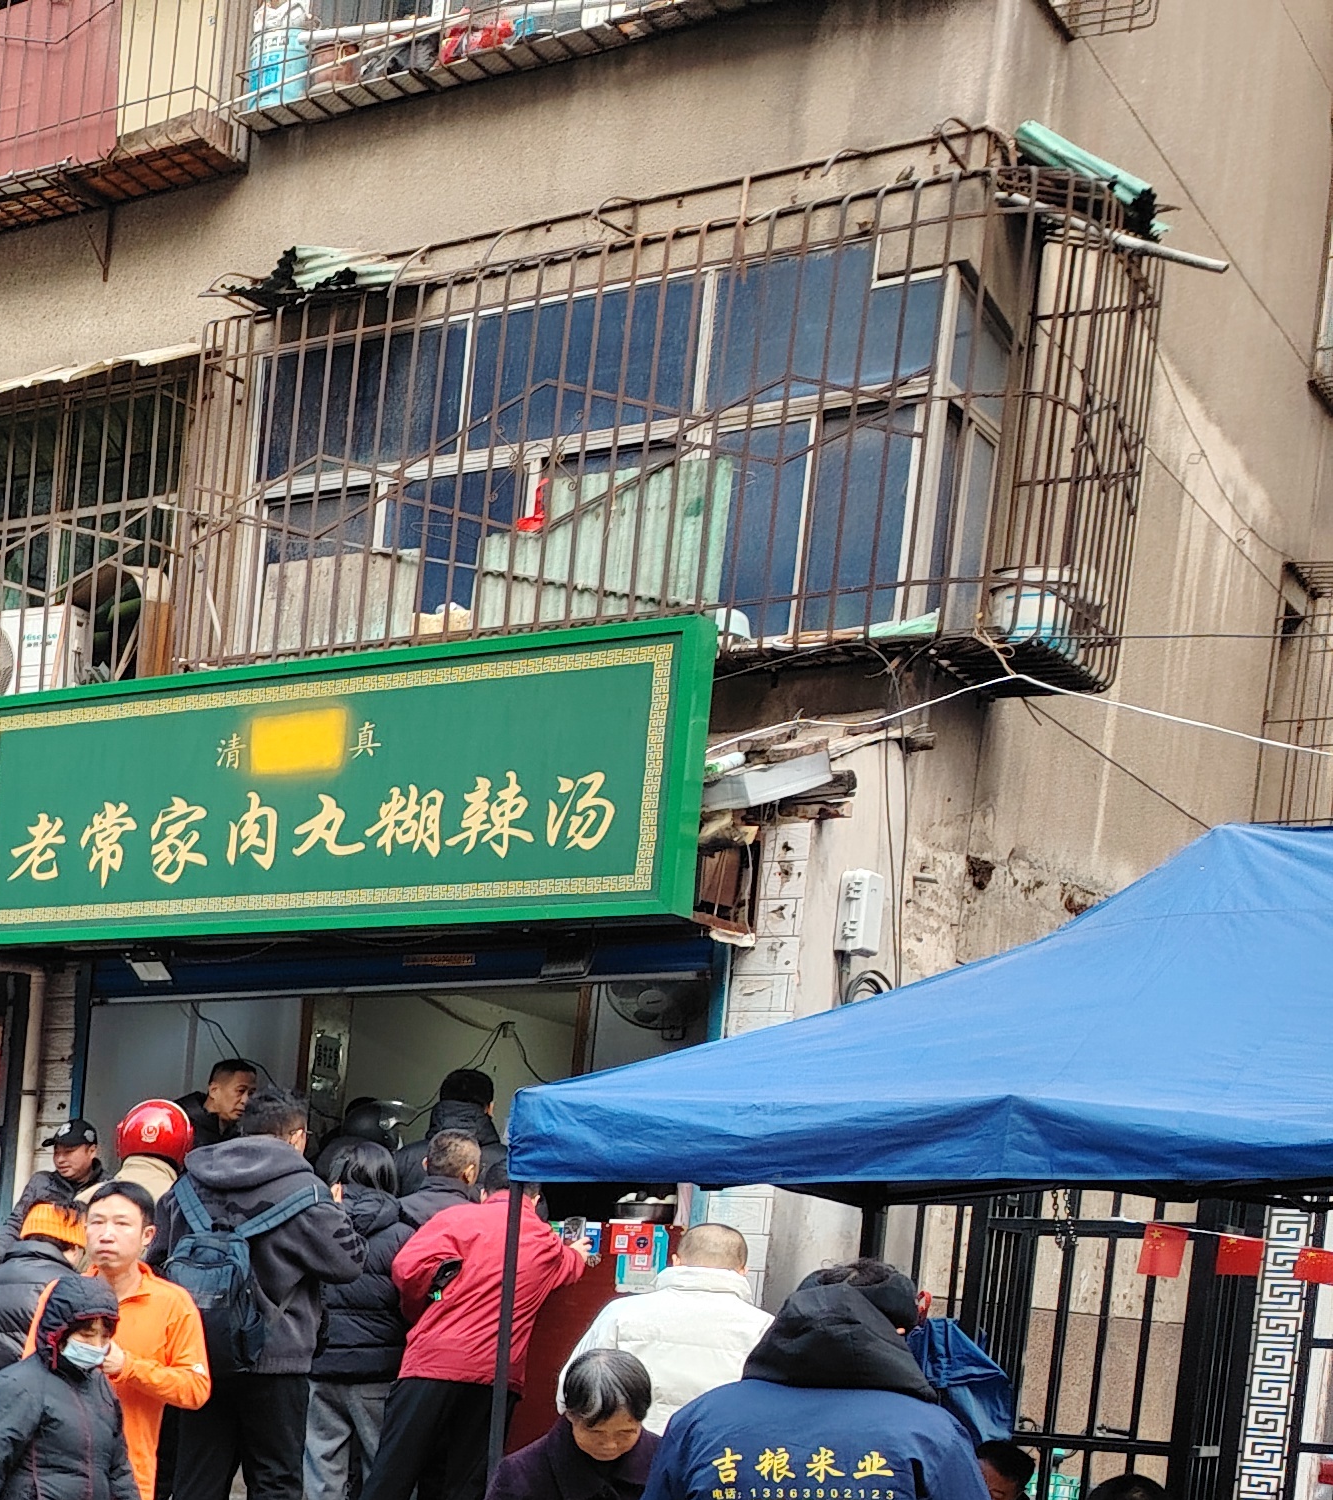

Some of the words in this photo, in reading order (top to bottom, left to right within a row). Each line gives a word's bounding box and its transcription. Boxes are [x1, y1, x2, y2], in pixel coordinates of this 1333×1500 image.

[216, 732, 245, 770] 清
[350, 722, 382, 758] 真
[8, 770, 616, 889] 老常家肉丸糊辣汤
[712, 1447, 895, 1484] 吉粮米业
[749, 1488, 894, 1500] 13363902123
